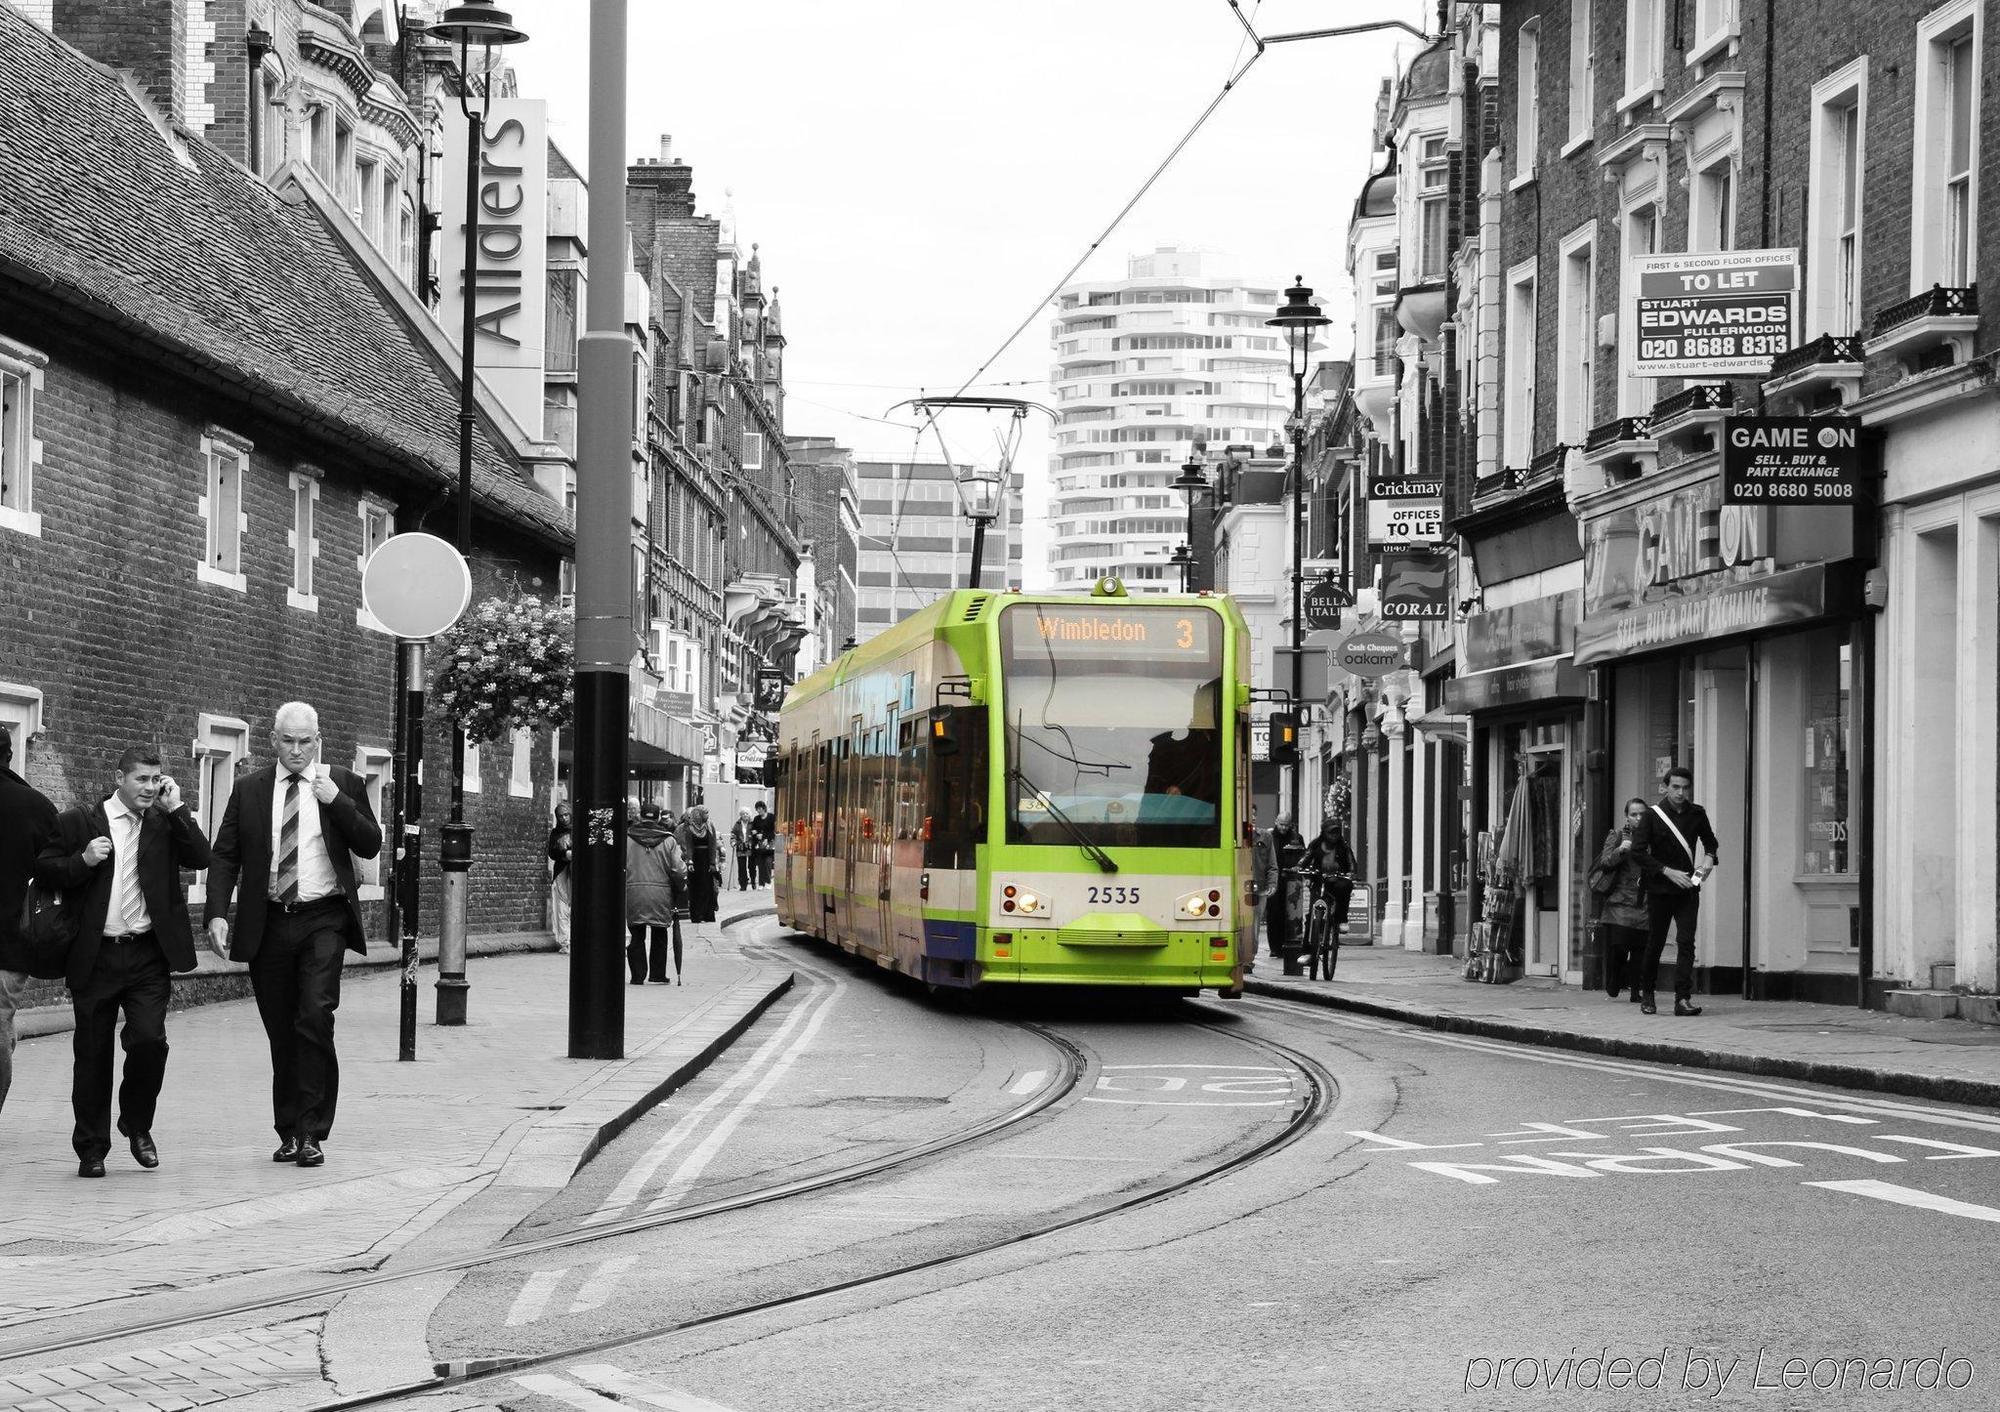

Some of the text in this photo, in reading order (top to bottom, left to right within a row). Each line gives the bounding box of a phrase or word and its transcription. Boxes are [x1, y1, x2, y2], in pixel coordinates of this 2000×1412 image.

[460, 118, 525, 347] Allders
[1646, 262, 1670, 270] FIRST
[1683, 259, 1720, 268] SECOND
[1723, 256, 1752, 265] FLOOR
[1755, 254, 1792, 263] OFFICES
[1680, 271, 1759, 291] TO LET
[1641, 299, 1700, 310] STUART
[1641, 306, 1787, 327] EDWARDS
[1683, 325, 1787, 337] FULLERMOON
[1641, 334, 1788, 359] 020 8688 8313
[1731, 427, 1856, 448] GAME ON
[1754, 455, 1828, 465] SELL BUY &
[1746, 467, 1840, 477] PART EXCHANGE
[1374, 481, 1443, 497] Crickmay
[1733, 483, 1853, 497] 020 8680 5008
[1393, 510, 1441, 520] OFFICES
[1387, 522, 1443, 536] TO LET
[1311, 597, 1348, 606] BELLA
[1383, 602, 1446, 616] CORAL
[1616, 615, 1637, 651] SELL
[1645, 609, 1668, 645] BUY
[1679, 600, 1708, 636] PART
[1708, 587, 1769, 632] EXCHANGE
[1036, 616, 1193, 649] Wimbledon 3
[1347, 644, 1398, 654] Cash Cheques
[1344, 653, 1394, 665] oakam
[1087, 886, 1140, 905] 2535
[1345, 1107, 1881, 1152] LEFT
[1406, 1134, 2000, 1185] TURN
